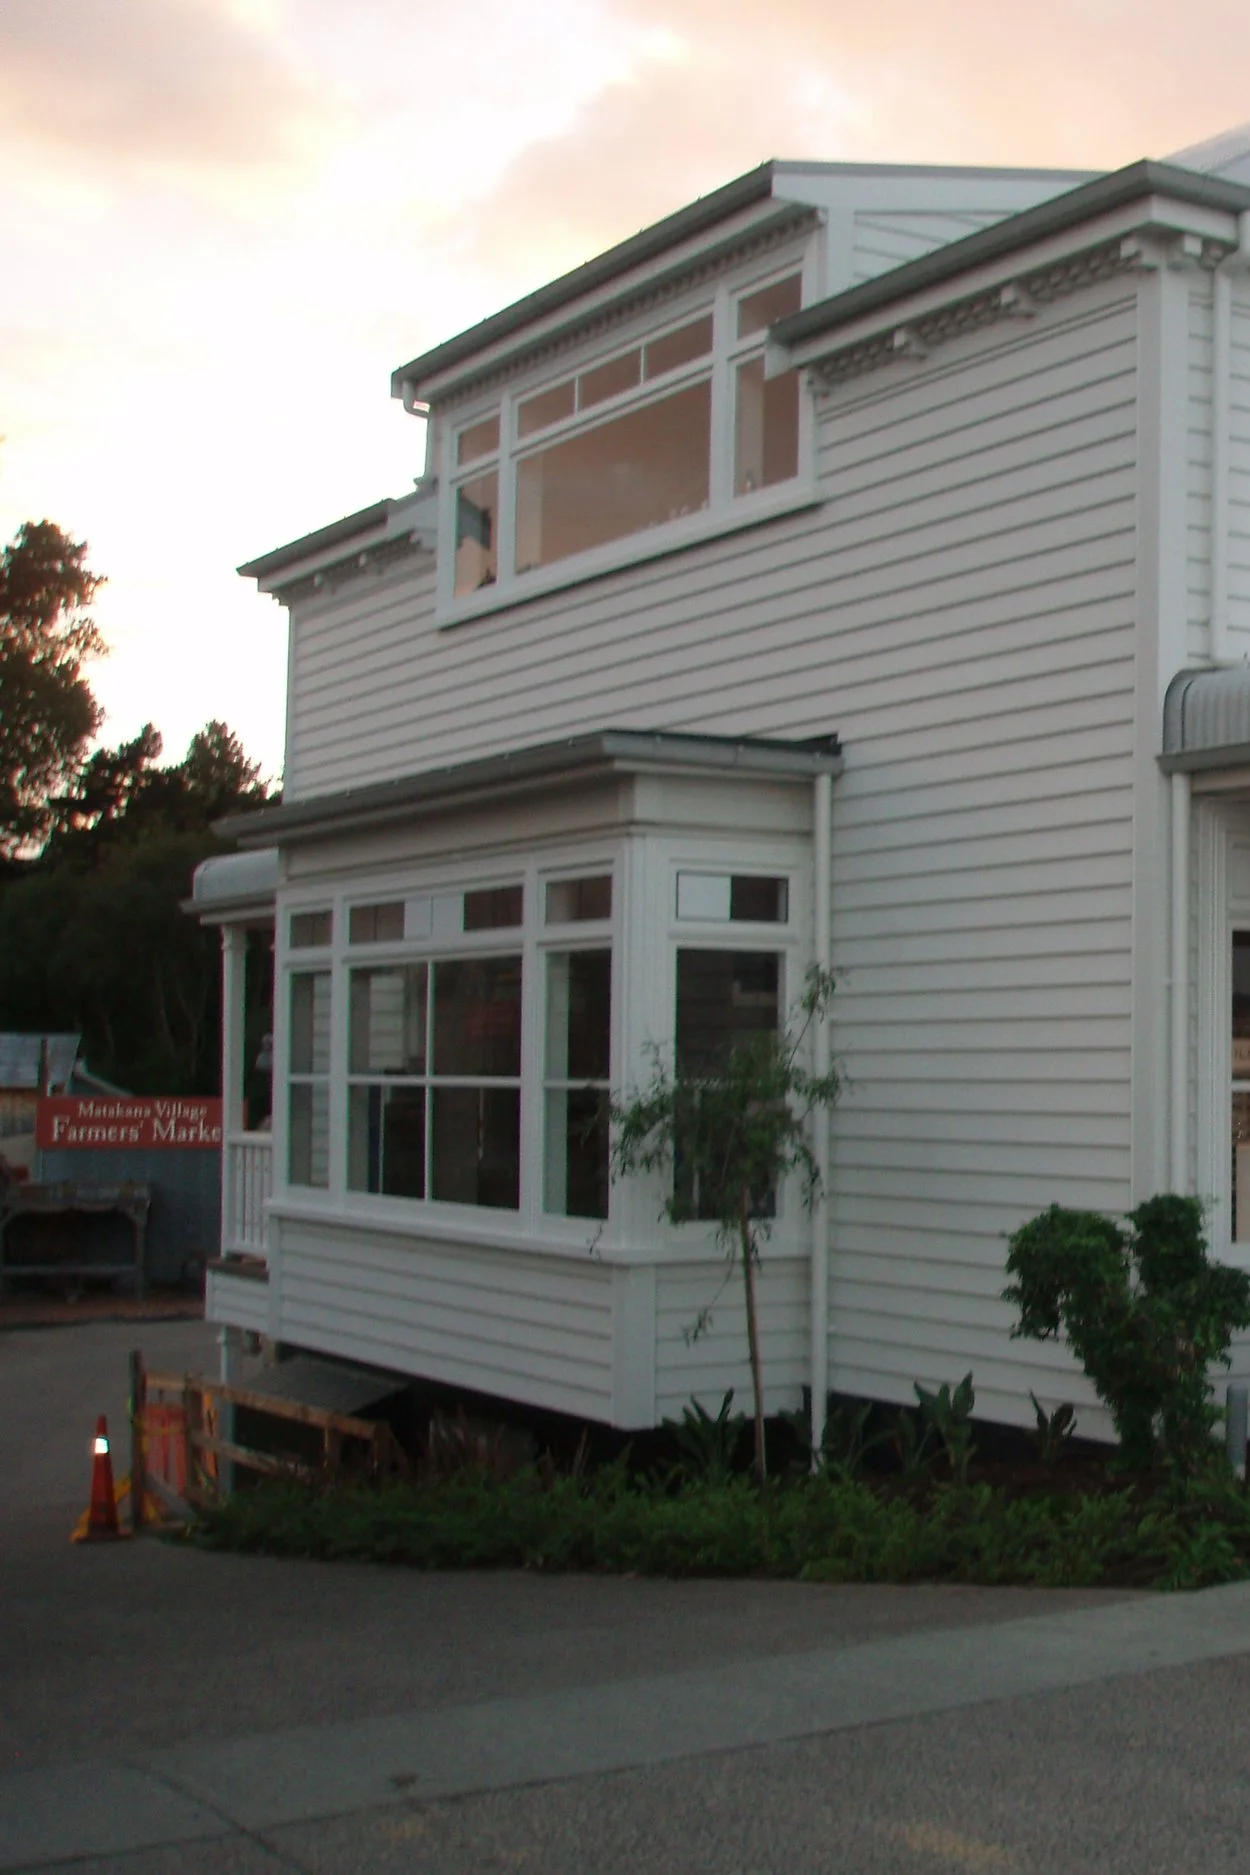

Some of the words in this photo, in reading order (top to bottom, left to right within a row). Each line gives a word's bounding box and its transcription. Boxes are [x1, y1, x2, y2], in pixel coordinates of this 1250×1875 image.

[79, 1101, 151, 1118] Matakana
[156, 1100, 208, 1121] Village
[52, 1114, 144, 1143] Farmers'
[153, 1116, 222, 1143] Marke
